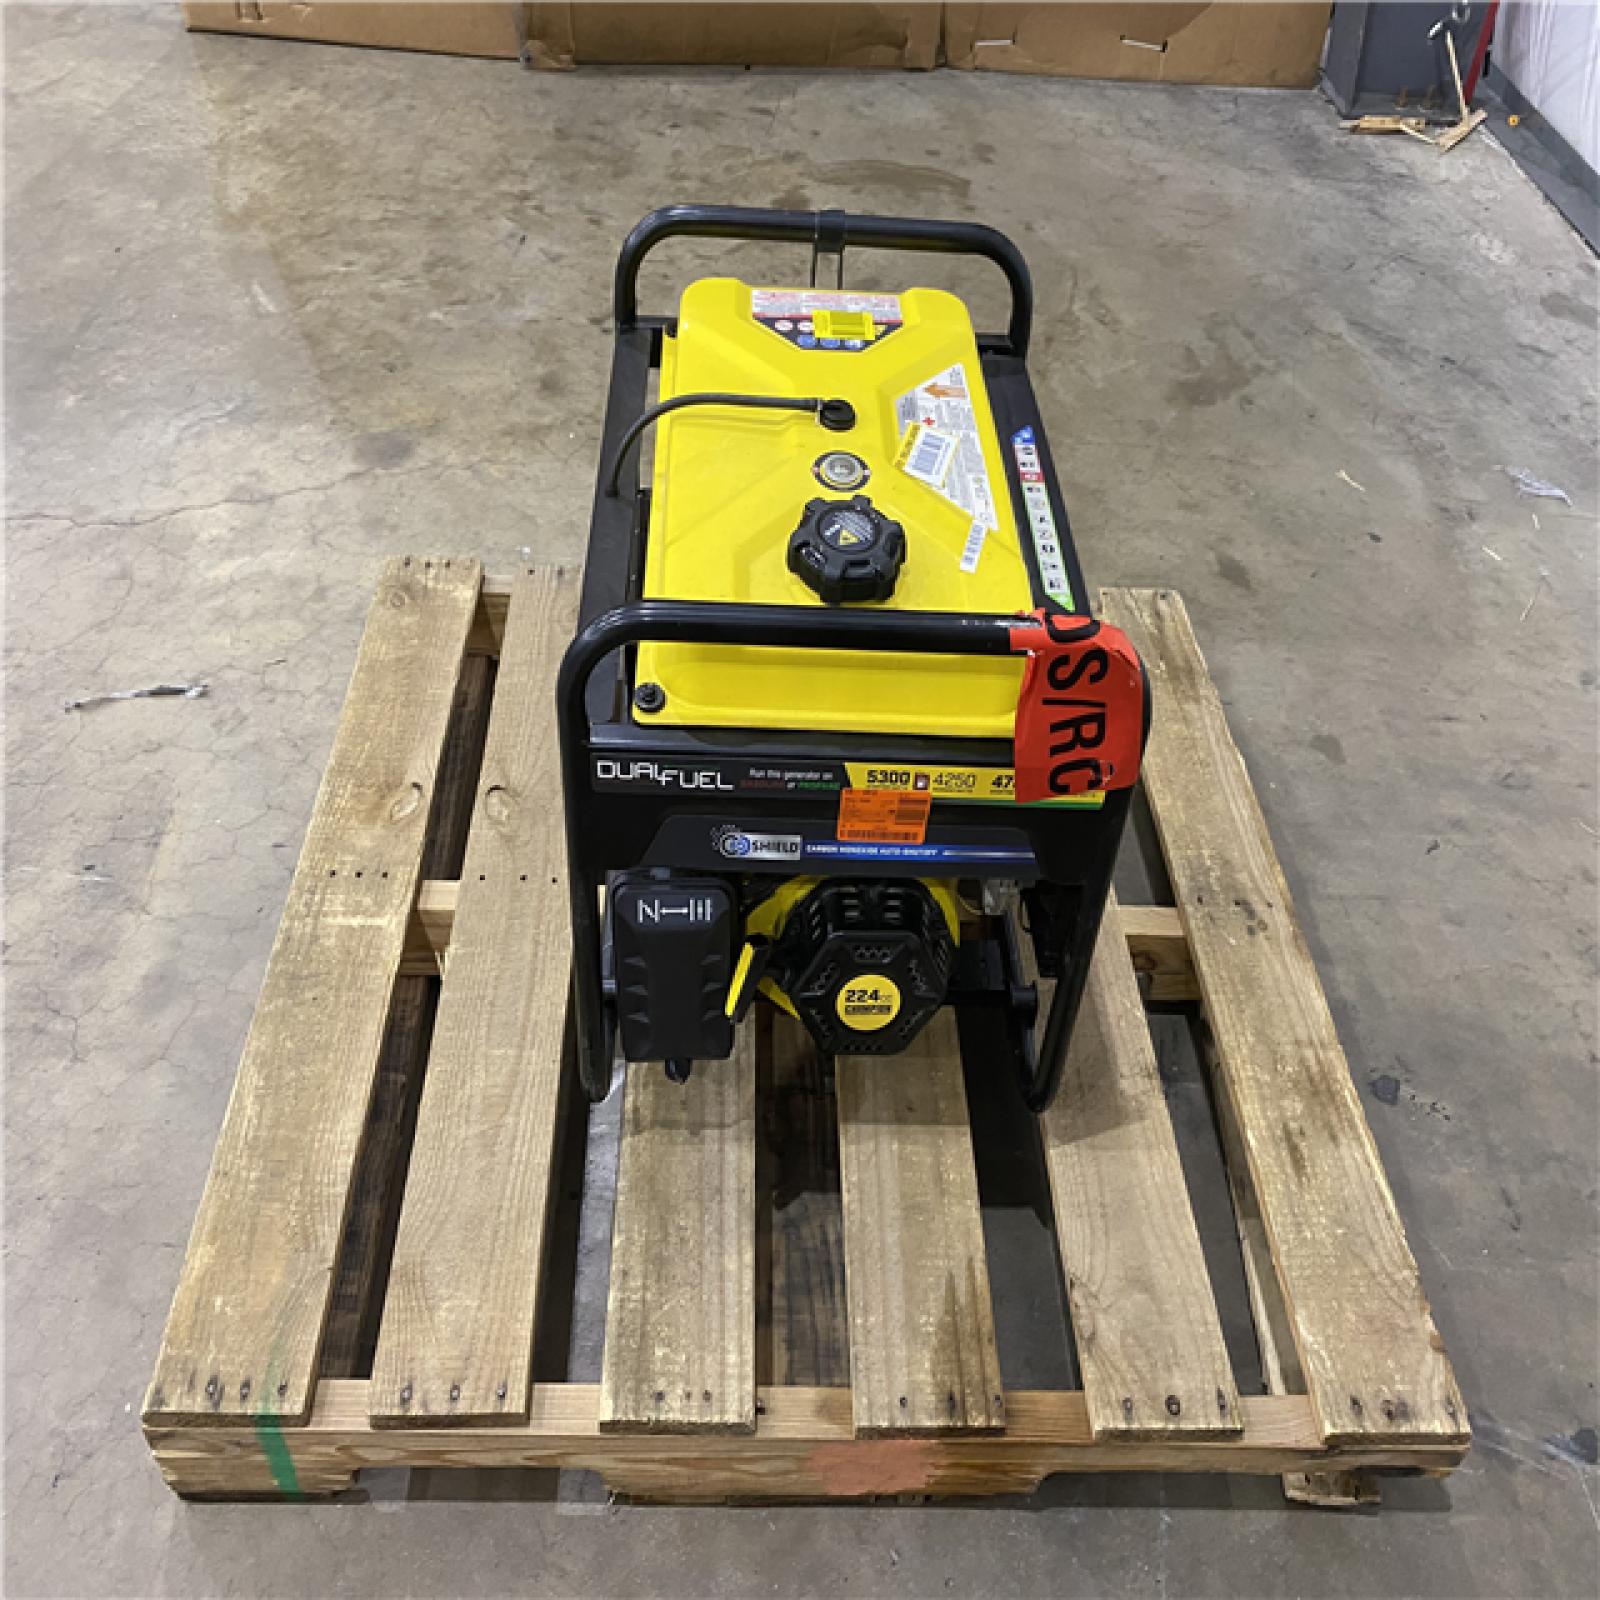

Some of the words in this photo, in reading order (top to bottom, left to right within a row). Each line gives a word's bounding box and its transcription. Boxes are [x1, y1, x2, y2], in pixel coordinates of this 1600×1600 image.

[866, 769, 911, 784] 5300
[932, 772, 977, 787] 4250
[991, 774, 1016, 788] 47
[752, 839, 800, 854] SHIELD
[845, 989, 880, 1003] 224
